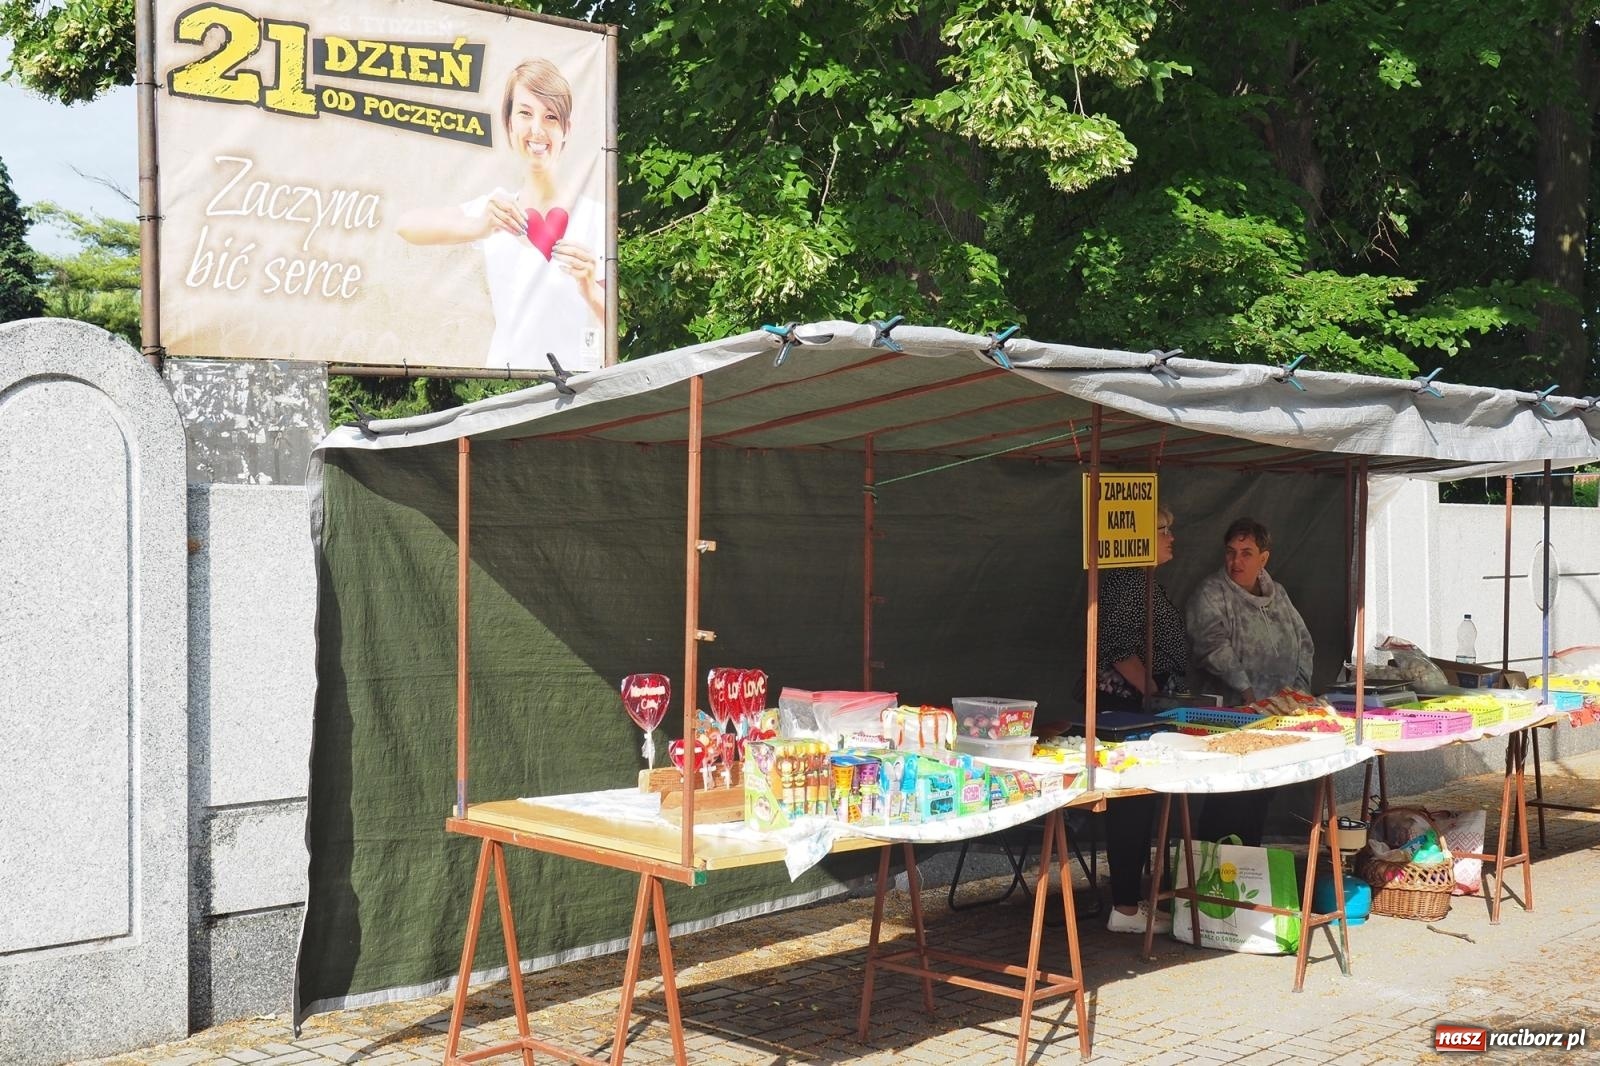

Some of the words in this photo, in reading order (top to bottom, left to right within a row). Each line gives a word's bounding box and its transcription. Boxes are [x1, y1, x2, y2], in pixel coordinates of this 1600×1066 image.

[168, 2, 320, 119] 21
[324, 36, 474, 89] DZIEŃ
[322, 88, 355, 112] OD
[364, 96, 485, 137] POCZĘCIA
[206, 156, 380, 250] Zaczyna
[185, 225, 255, 291] bić
[263, 253, 362, 299] serce
[1104, 482, 1152, 501] ZAPŁACISZ
[1108, 511, 1136, 533] KARTĄ
[1098, 540, 1110, 559] UB
[1113, 538, 1150, 558] BLIKIEM
[743, 675, 766, 699] LOVE
